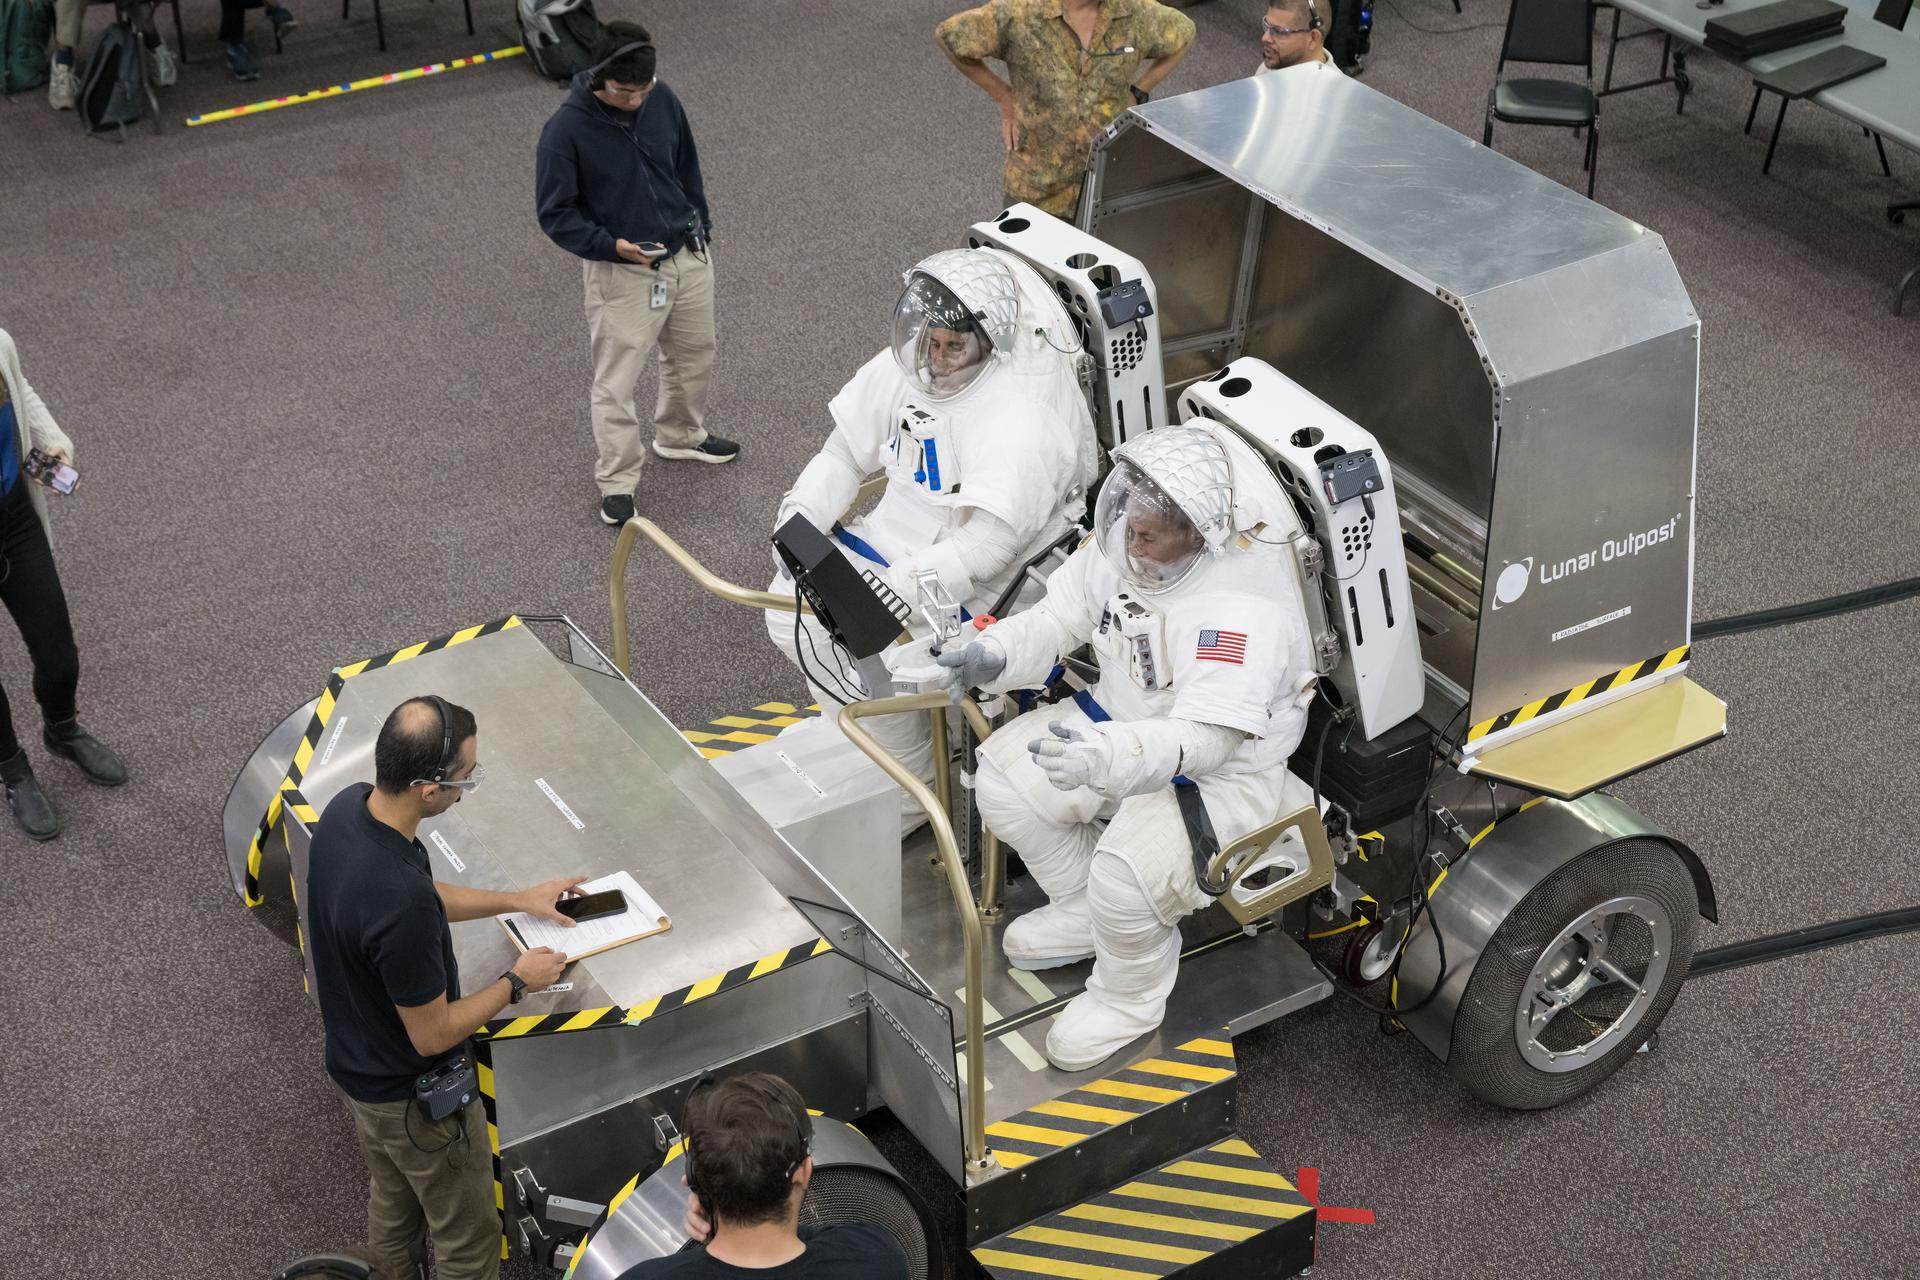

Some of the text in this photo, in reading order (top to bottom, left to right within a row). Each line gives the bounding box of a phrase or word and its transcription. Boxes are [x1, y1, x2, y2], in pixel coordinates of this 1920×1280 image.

[1540, 517, 1677, 584] Lunar Outpost
[1560, 612, 1619, 637] RADIATOR SURFACE
